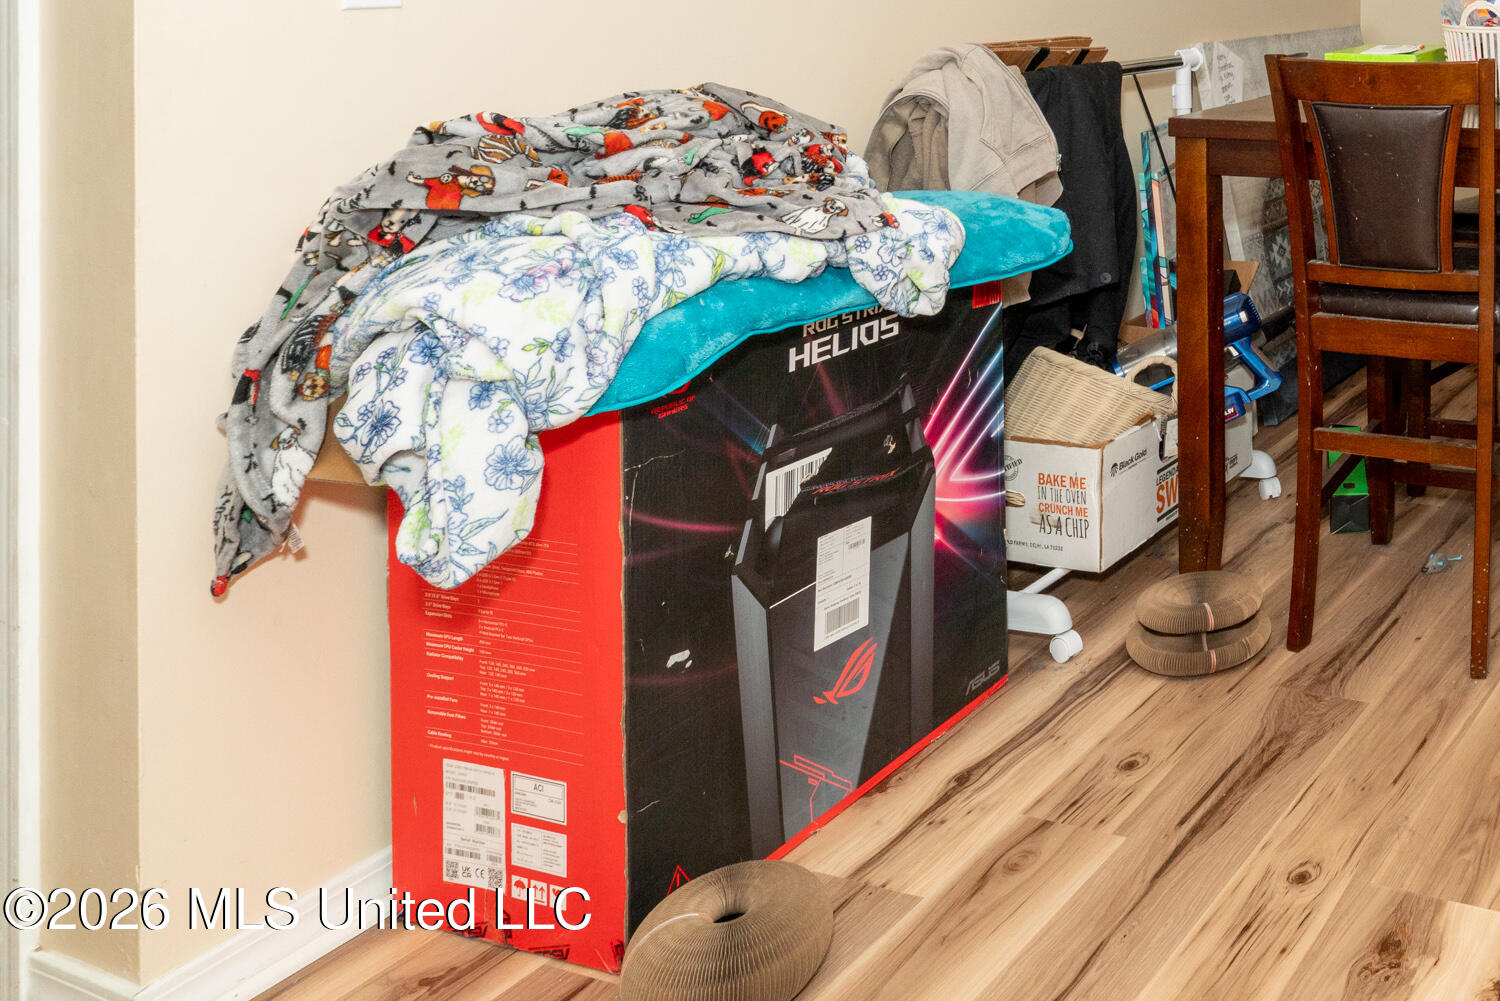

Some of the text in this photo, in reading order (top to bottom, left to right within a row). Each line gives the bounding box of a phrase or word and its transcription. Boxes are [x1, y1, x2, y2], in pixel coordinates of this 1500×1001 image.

[803, 314, 839, 338] ROG
[788, 313, 900, 373] HELIOS
[1118, 456, 1135, 471] Black
[1134, 449, 1148, 463] Gold
[1038, 472, 1087, 490] BAKE ME
[1038, 485, 1087, 505] IN THE OVEN
[1156, 474, 1179, 514] SW
[1038, 503, 1088, 518] CRUNCH ME
[1039, 514, 1090, 539] AS A CHIP
[965, 660, 1000, 697] ASUS
